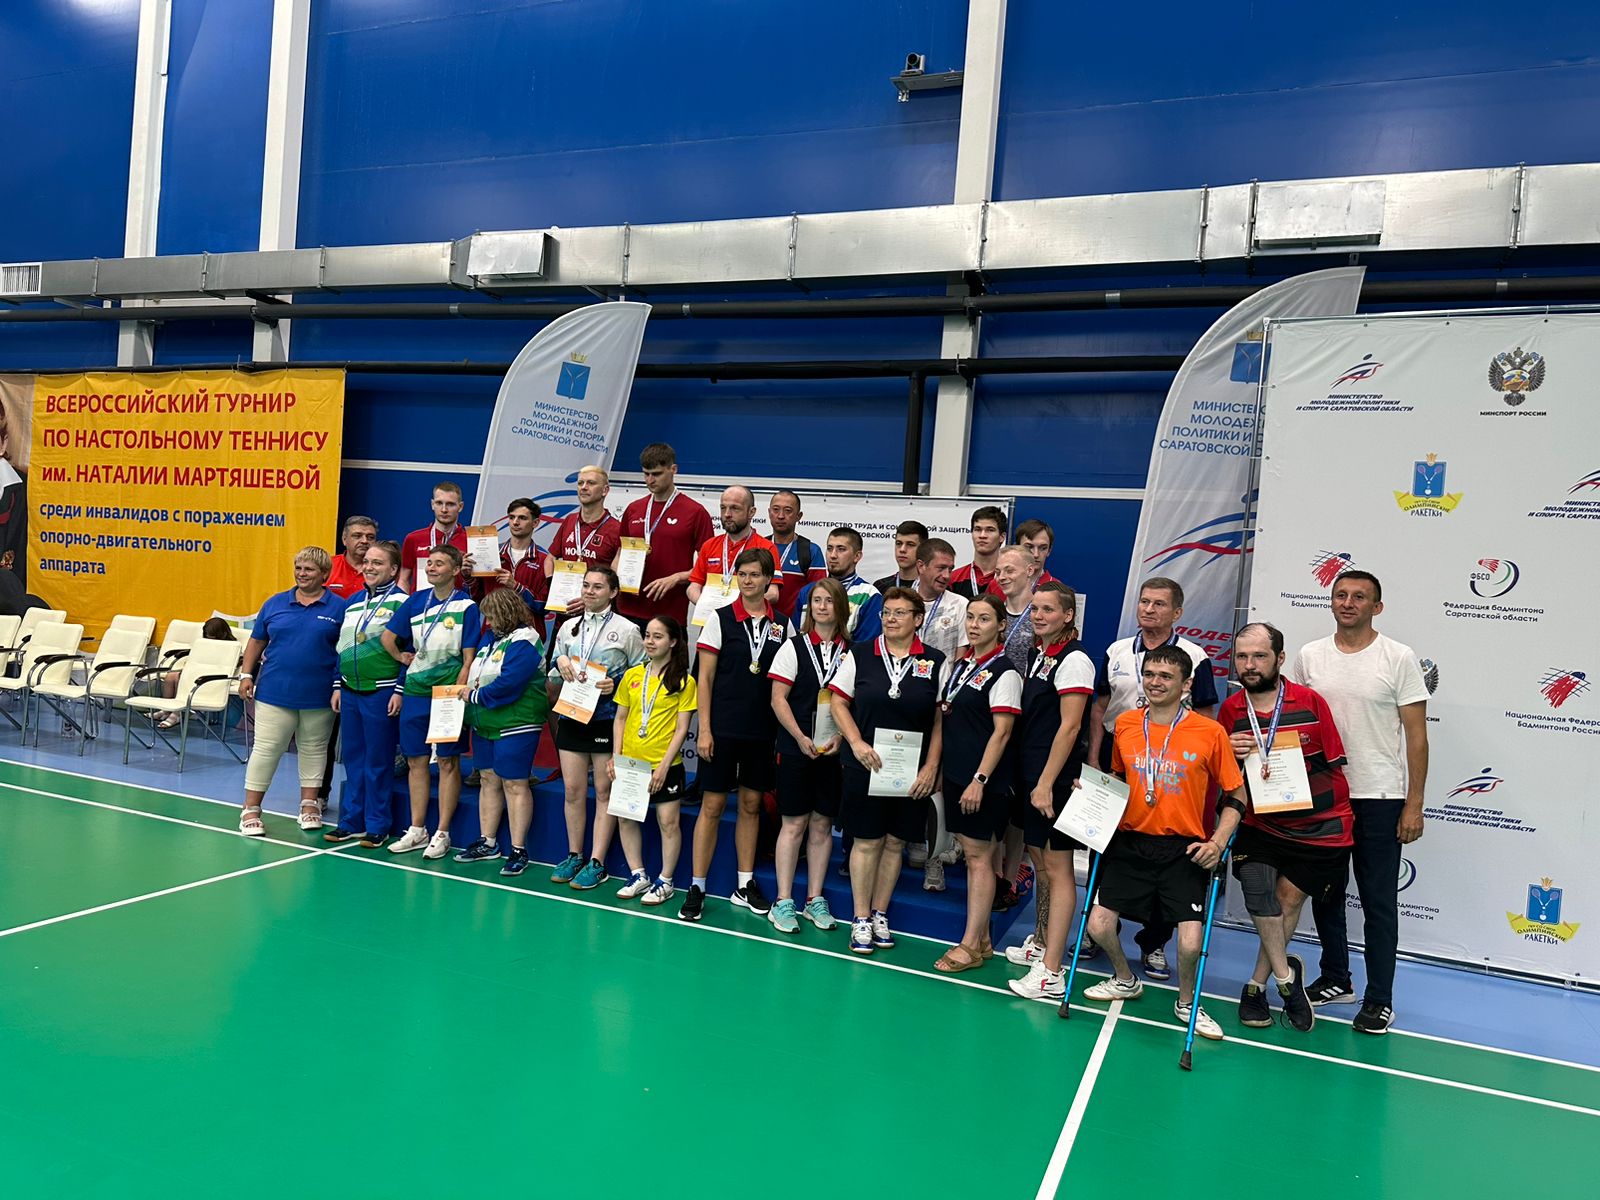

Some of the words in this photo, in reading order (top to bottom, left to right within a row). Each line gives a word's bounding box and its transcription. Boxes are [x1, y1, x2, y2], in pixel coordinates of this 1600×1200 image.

[45, 388, 209, 413] ВСЕРОССИЙСКИЙ
[214, 392, 297, 413] ТУРНИР
[1193, 401, 1266, 415] МИНИСТЕС
[534, 401, 600, 422] МИНИСТЕРСТВО
[532, 410, 598, 432] МОЛОДЕЖНОЙ
[520, 417, 565, 436] ПОЛИТИКИ
[565, 428, 573, 437] И
[573, 430, 605, 443] СПОРТА
[1172, 425, 1240, 441] ПОЛИТИКИ
[1242, 432, 1252, 442] И
[43, 429, 70, 448] ПО
[75, 429, 224, 450] НАСТОЛЬНОМУ
[229, 431, 329, 452] ТЕННИСУ
[511, 425, 571, 446] САРАТОВСКОЙ
[572, 440, 609, 454] ОБЛАСТИ
[1159, 439, 1250, 456] САРАТОВСКОЙ
[42, 466, 72, 482] им.
[76, 464, 168, 486] НАТАЛИИ
[173, 464, 321, 490] МАРТЯШЕВОЙ
[39, 502, 82, 521] среди
[85, 505, 169, 524] инвалидов
[172, 510, 181, 522] с
[184, 511, 286, 528] поражением
[1410, 508, 1443, 517] РАКЕТКИ
[39, 530, 212, 553] опорно-двигательного
[564, 547, 597, 559] МОВА
[39, 557, 106, 575] аппарата
[1470, 572, 1491, 581] ФБСО
[1280, 592, 1331, 601] Национальна
[1291, 601, 1333, 609] Бадминтон
[1443, 601, 1490, 611] Федерация
[1491, 604, 1544, 614] бадминтона
[1445, 610, 1501, 620] Саратовской
[1502, 613, 1538, 622] области
[1175, 625, 1232, 642] ЛОДЕ
[1505, 710, 1567, 722] Национальная
[1517, 720, 1570, 732] Бадминтона
[1424, 807, 1480, 819] МОЛОДЕЖНОЙ
[1479, 813, 1522, 825] ПОЛИТИКИ
[1443, 803, 1503, 816] МИНИСТЕРСТВО
[1446, 816, 1500, 828] САРАТОВСКОЙ
[1500, 823, 1537, 833] ОБЛАСТИ
[1397, 902, 1440, 913] дминтона
[1400, 911, 1434, 920] области
[1524, 933, 1558, 945] РАКЕТКИ
